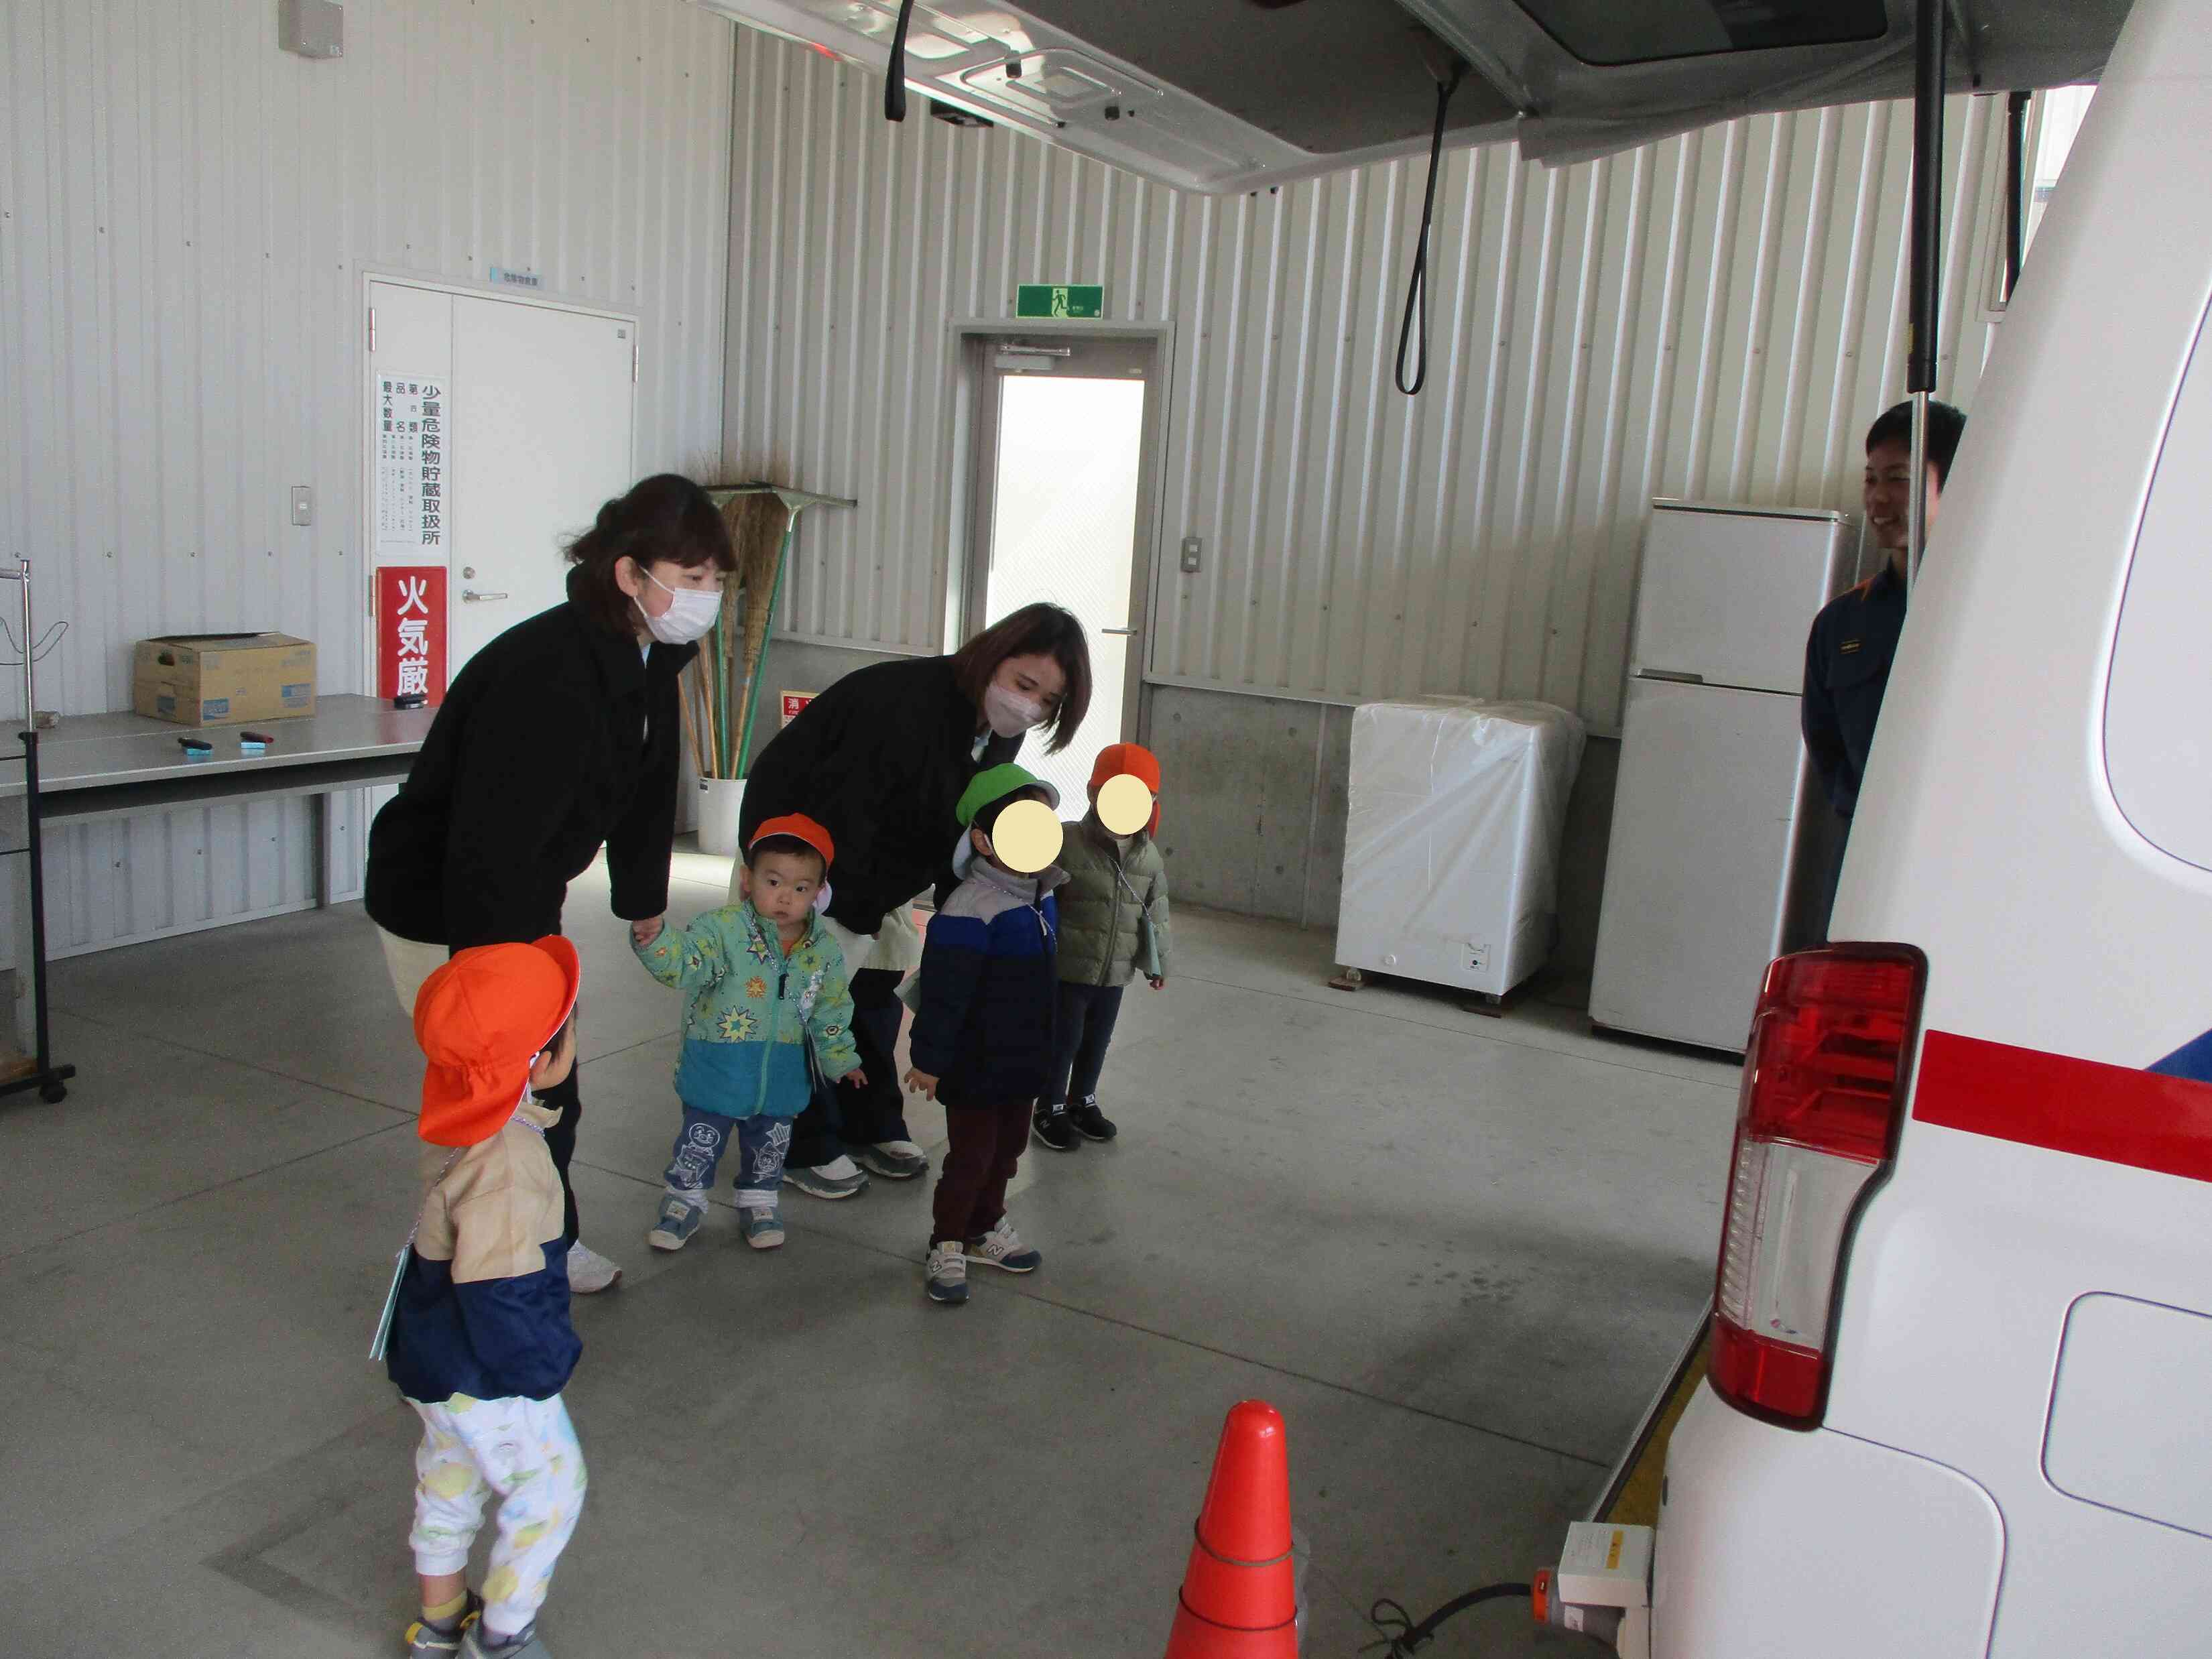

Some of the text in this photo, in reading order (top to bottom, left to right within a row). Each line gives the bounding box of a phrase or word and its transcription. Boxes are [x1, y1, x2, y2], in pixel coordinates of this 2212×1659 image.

[422, 385, 441, 545] 少量危険物貯蔵取扱所
[397, 575, 429, 704] 火気厳
